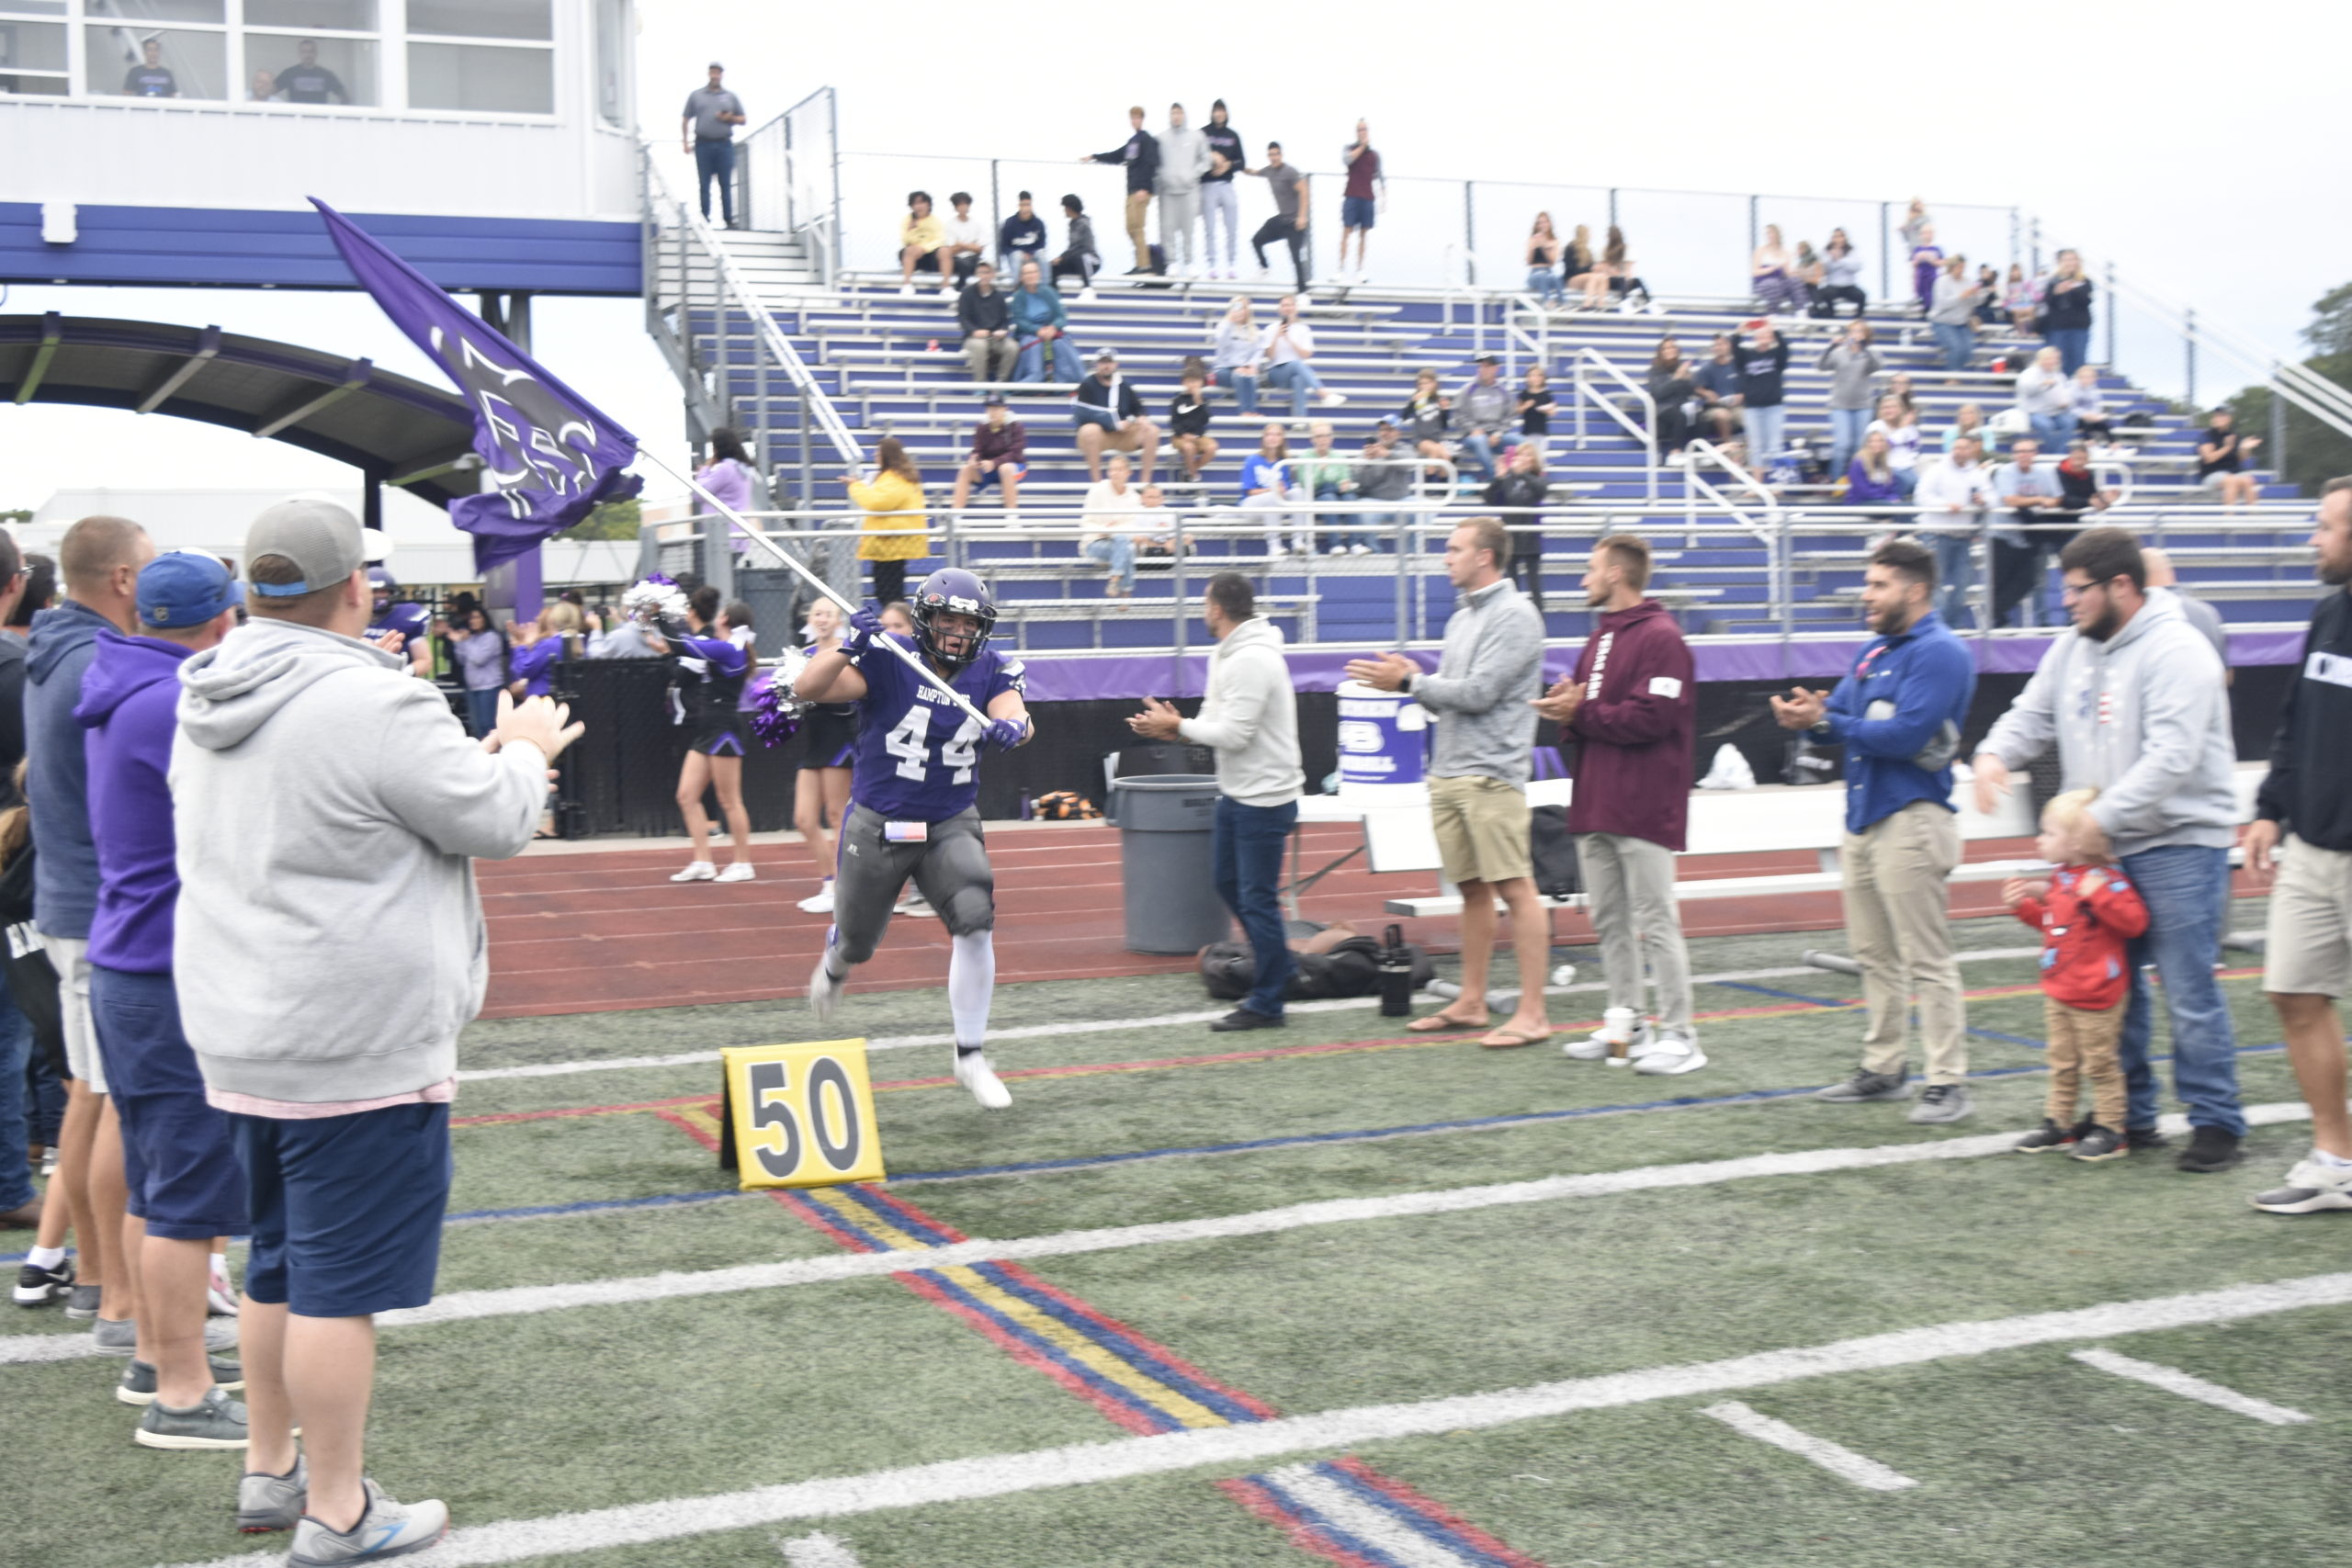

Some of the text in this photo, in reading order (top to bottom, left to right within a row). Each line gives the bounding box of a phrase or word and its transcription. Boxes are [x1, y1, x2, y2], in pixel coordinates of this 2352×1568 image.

[916, 684, 951, 706] HAMPTON
[886, 705, 982, 785] 44
[749, 1055, 861, 1179] 50
